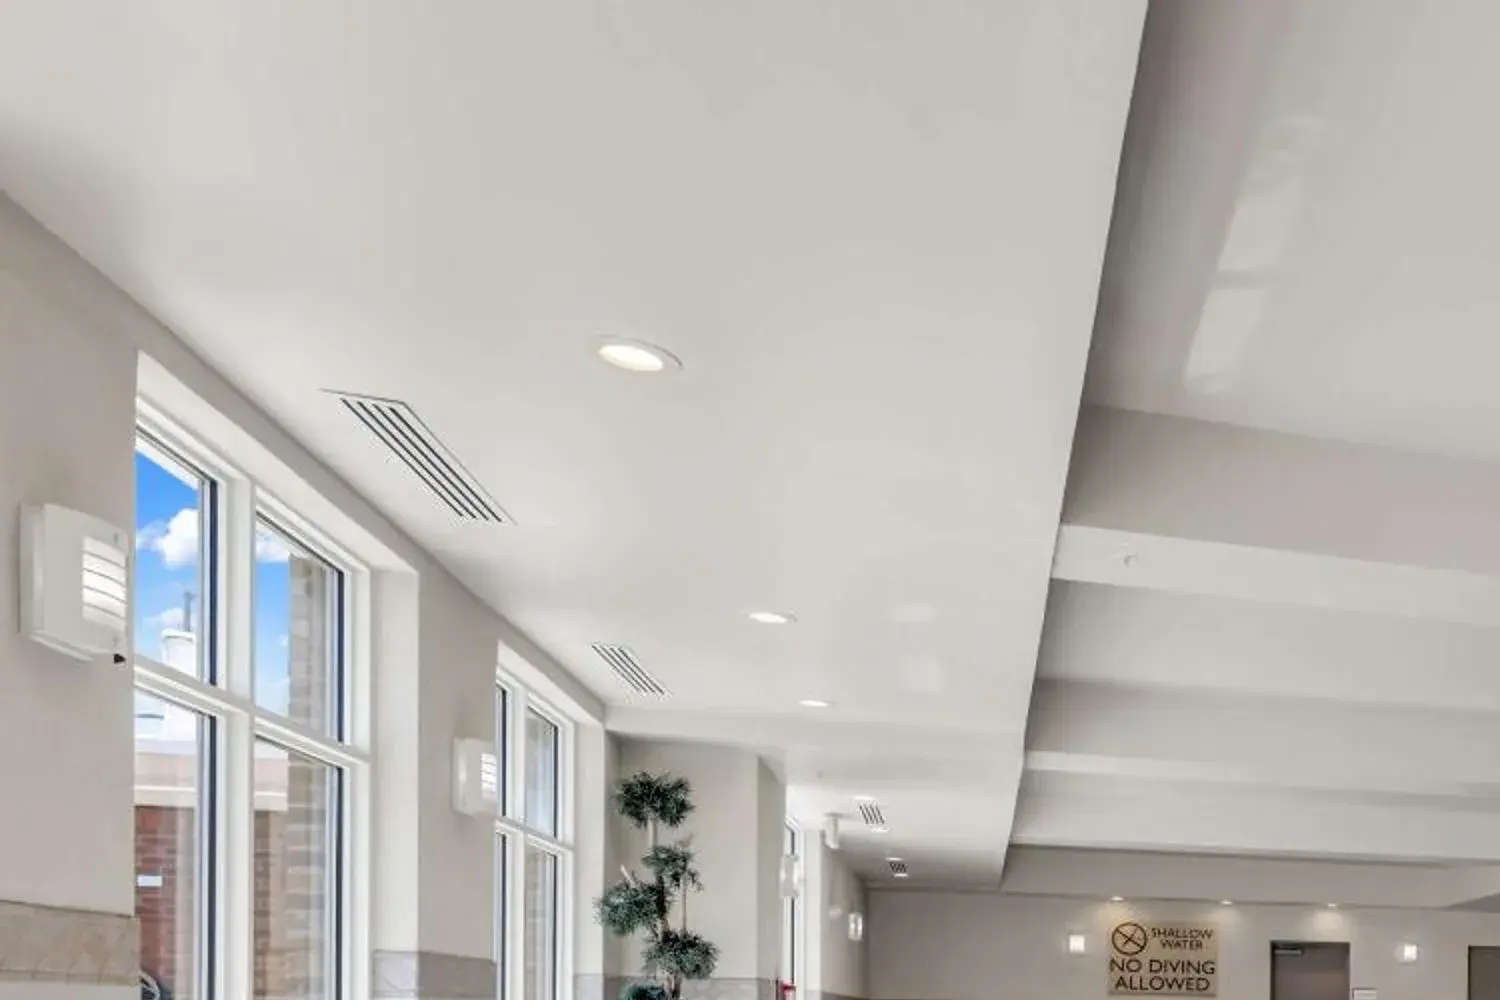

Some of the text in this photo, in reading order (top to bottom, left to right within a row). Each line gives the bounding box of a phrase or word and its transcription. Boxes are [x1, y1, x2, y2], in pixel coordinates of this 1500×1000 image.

[1151, 927, 1213, 939] SHALLOW
[1160, 939, 1203, 950] WATER
[1109, 958, 1216, 975] NO DIVING
[1115, 976, 1211, 991] ALLOWED
